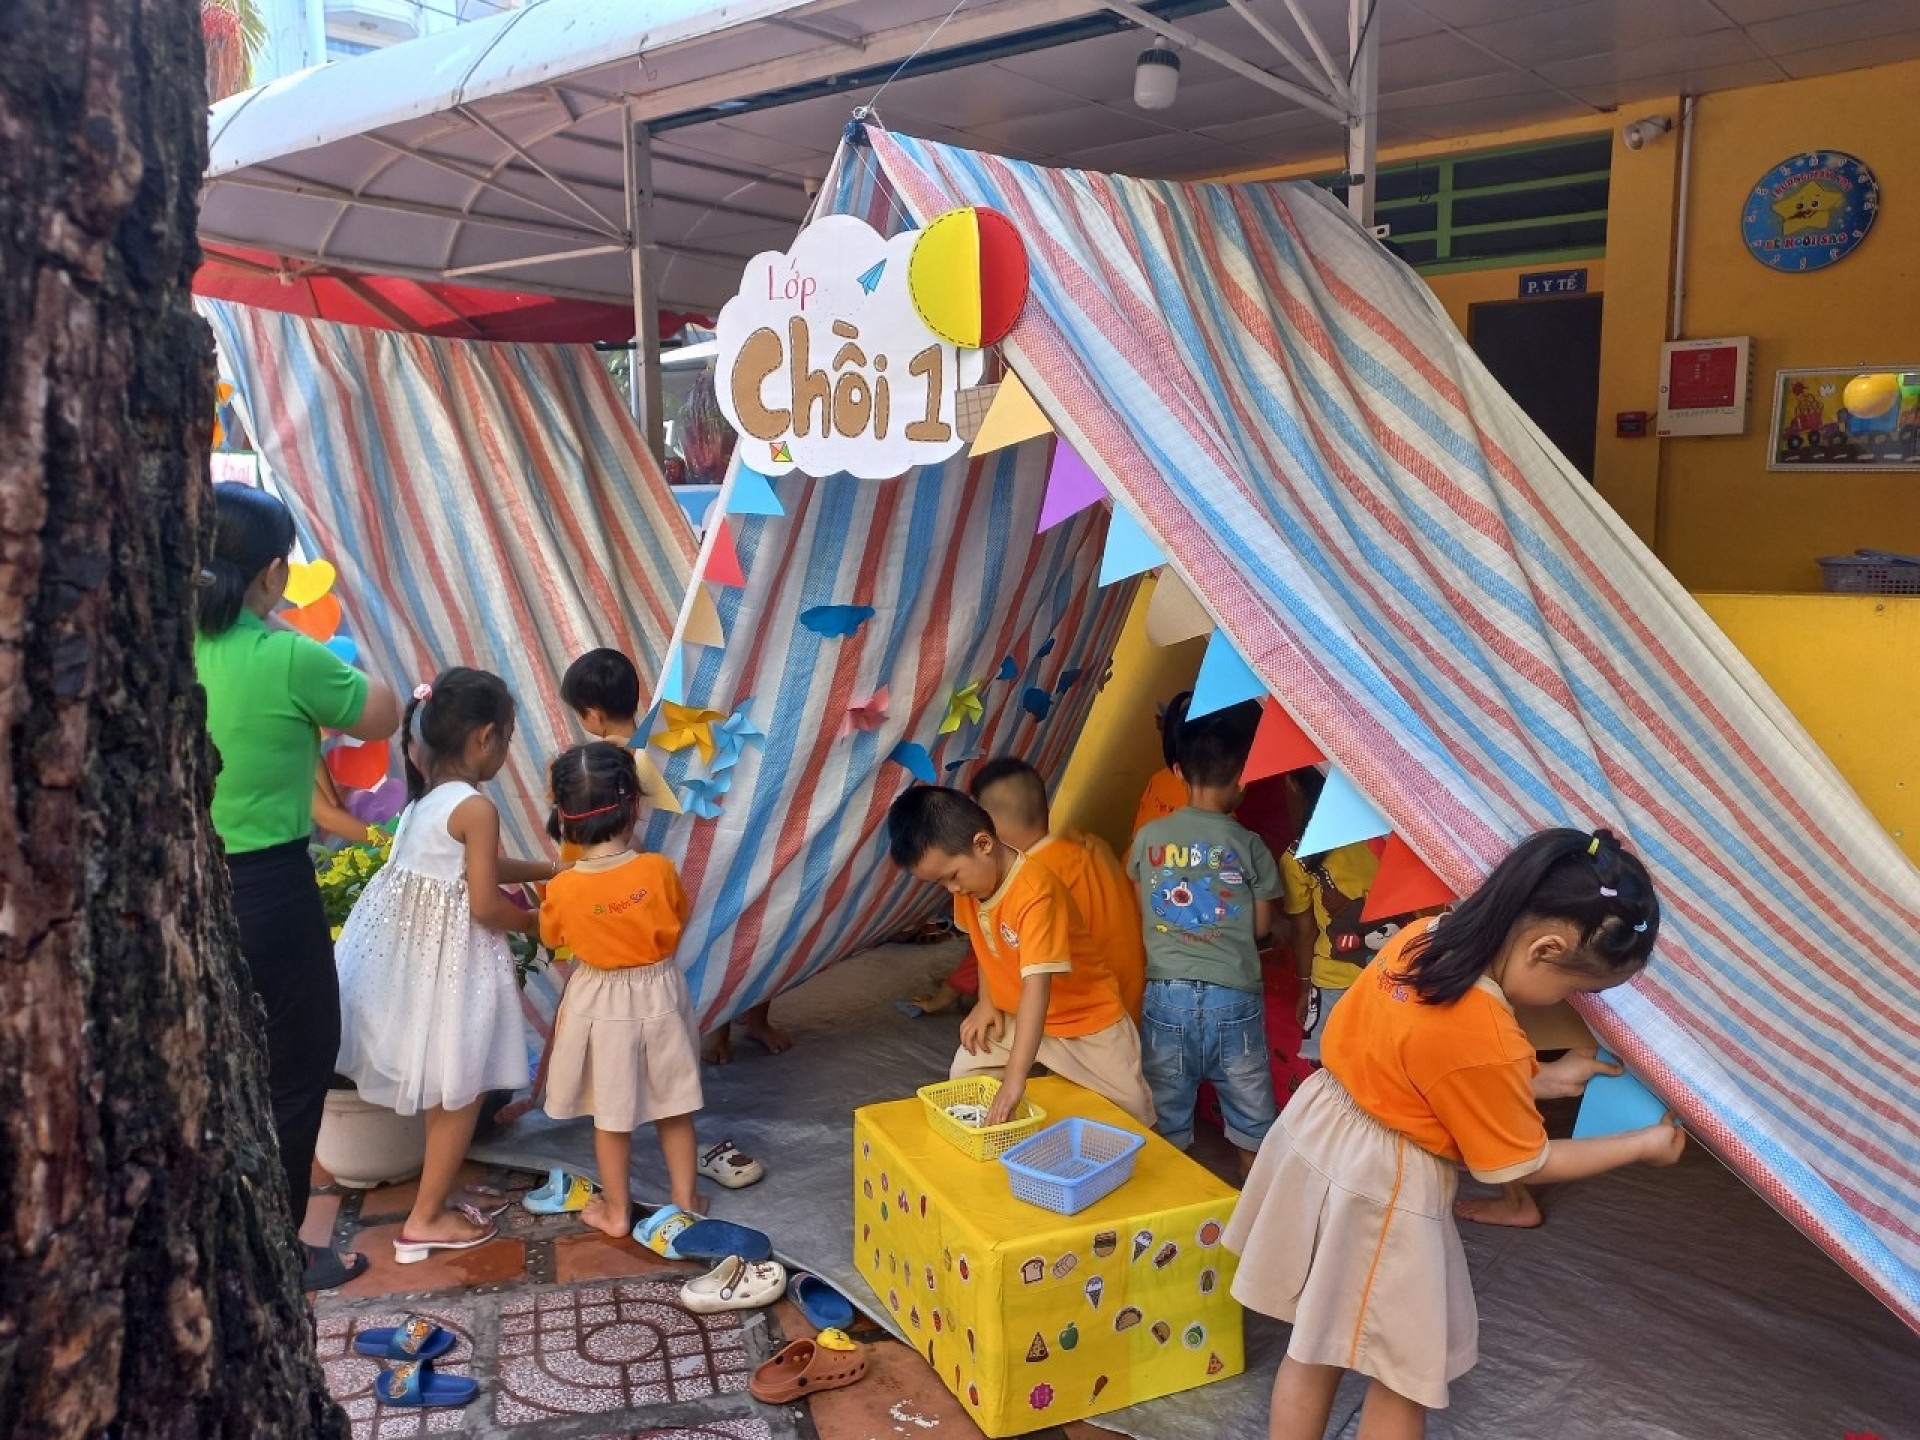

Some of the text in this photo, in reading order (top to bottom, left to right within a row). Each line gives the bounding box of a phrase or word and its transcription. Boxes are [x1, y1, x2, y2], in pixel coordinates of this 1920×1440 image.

[768, 257, 817, 311] Lớp
[1527, 272, 1578, 294] P. Y TẾ
[731, 315, 952, 442] Chồi 1
